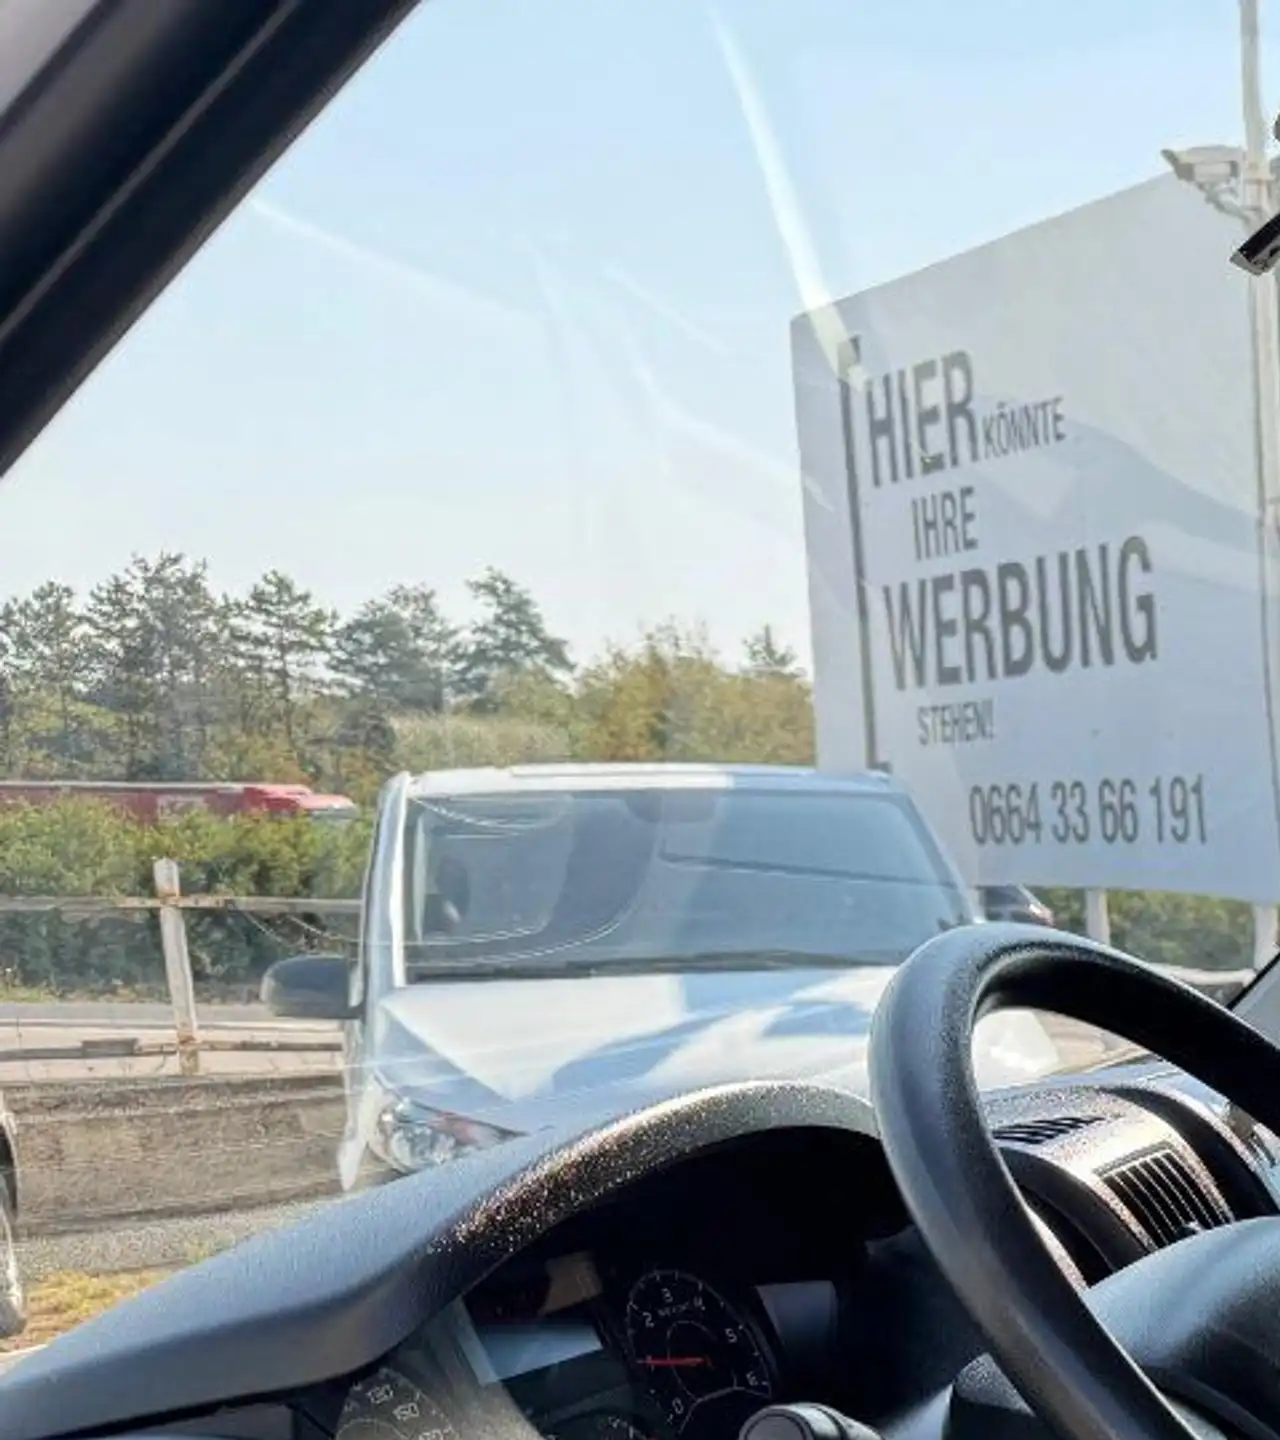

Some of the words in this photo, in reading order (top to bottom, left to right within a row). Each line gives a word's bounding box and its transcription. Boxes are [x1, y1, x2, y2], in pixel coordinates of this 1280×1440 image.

[866, 350, 980, 487] HIER
[982, 395, 1066, 459] KÖNNTE
[911, 486, 979, 561] IHRE
[883, 536, 1158, 691] WERBUNG
[917, 700, 994, 746] STEHEN!
[969, 782, 1042, 845] 0664
[1051, 780, 1089, 844] 33
[1099, 778, 1139, 844] 66
[1149, 773, 1207, 844] 191
